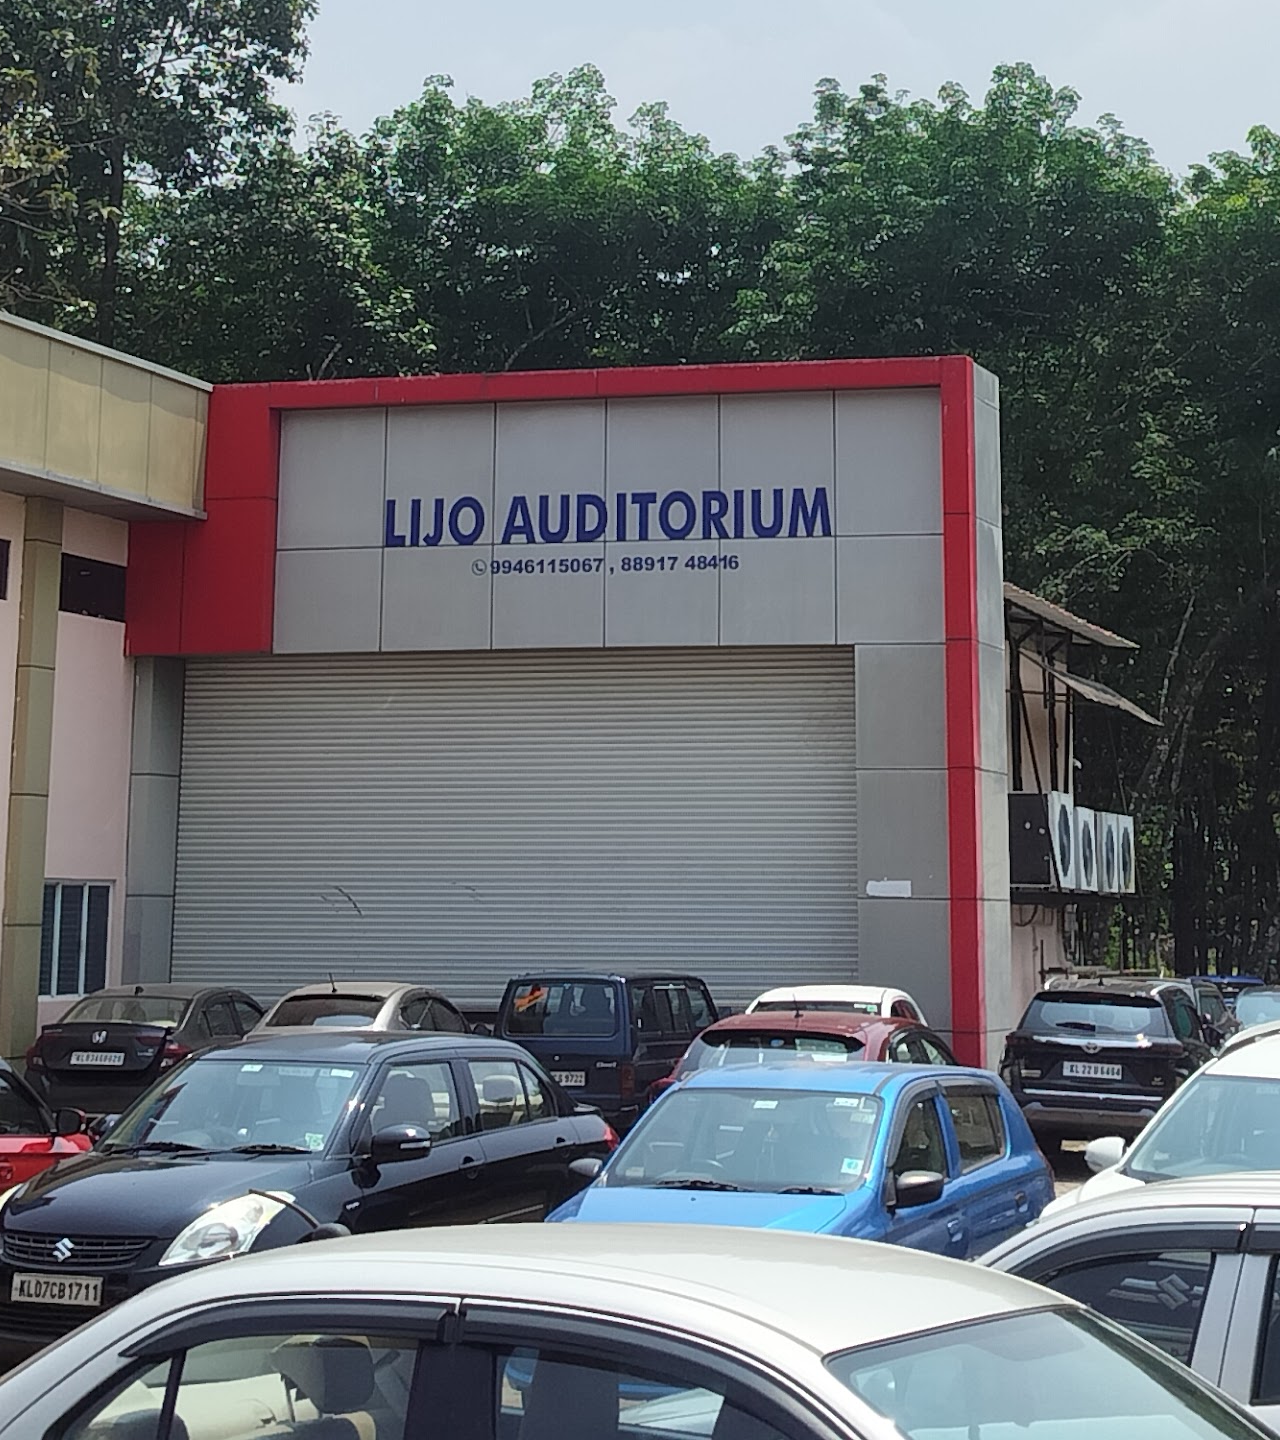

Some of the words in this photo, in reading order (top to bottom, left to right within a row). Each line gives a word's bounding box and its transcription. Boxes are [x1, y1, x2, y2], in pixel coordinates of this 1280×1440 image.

[384, 496, 484, 547] LIJO
[501, 487, 832, 544] AUDITORIUM
[490, 558, 604, 575] 9946115067
[621, 556, 679, 572] 88917
[684, 554, 739, 571] 48416
[1069, 1064, 1079, 1074] KL
[1082, 1064, 1092, 1075] 22
[18, 1279, 99, 1302] KL07CB1711
